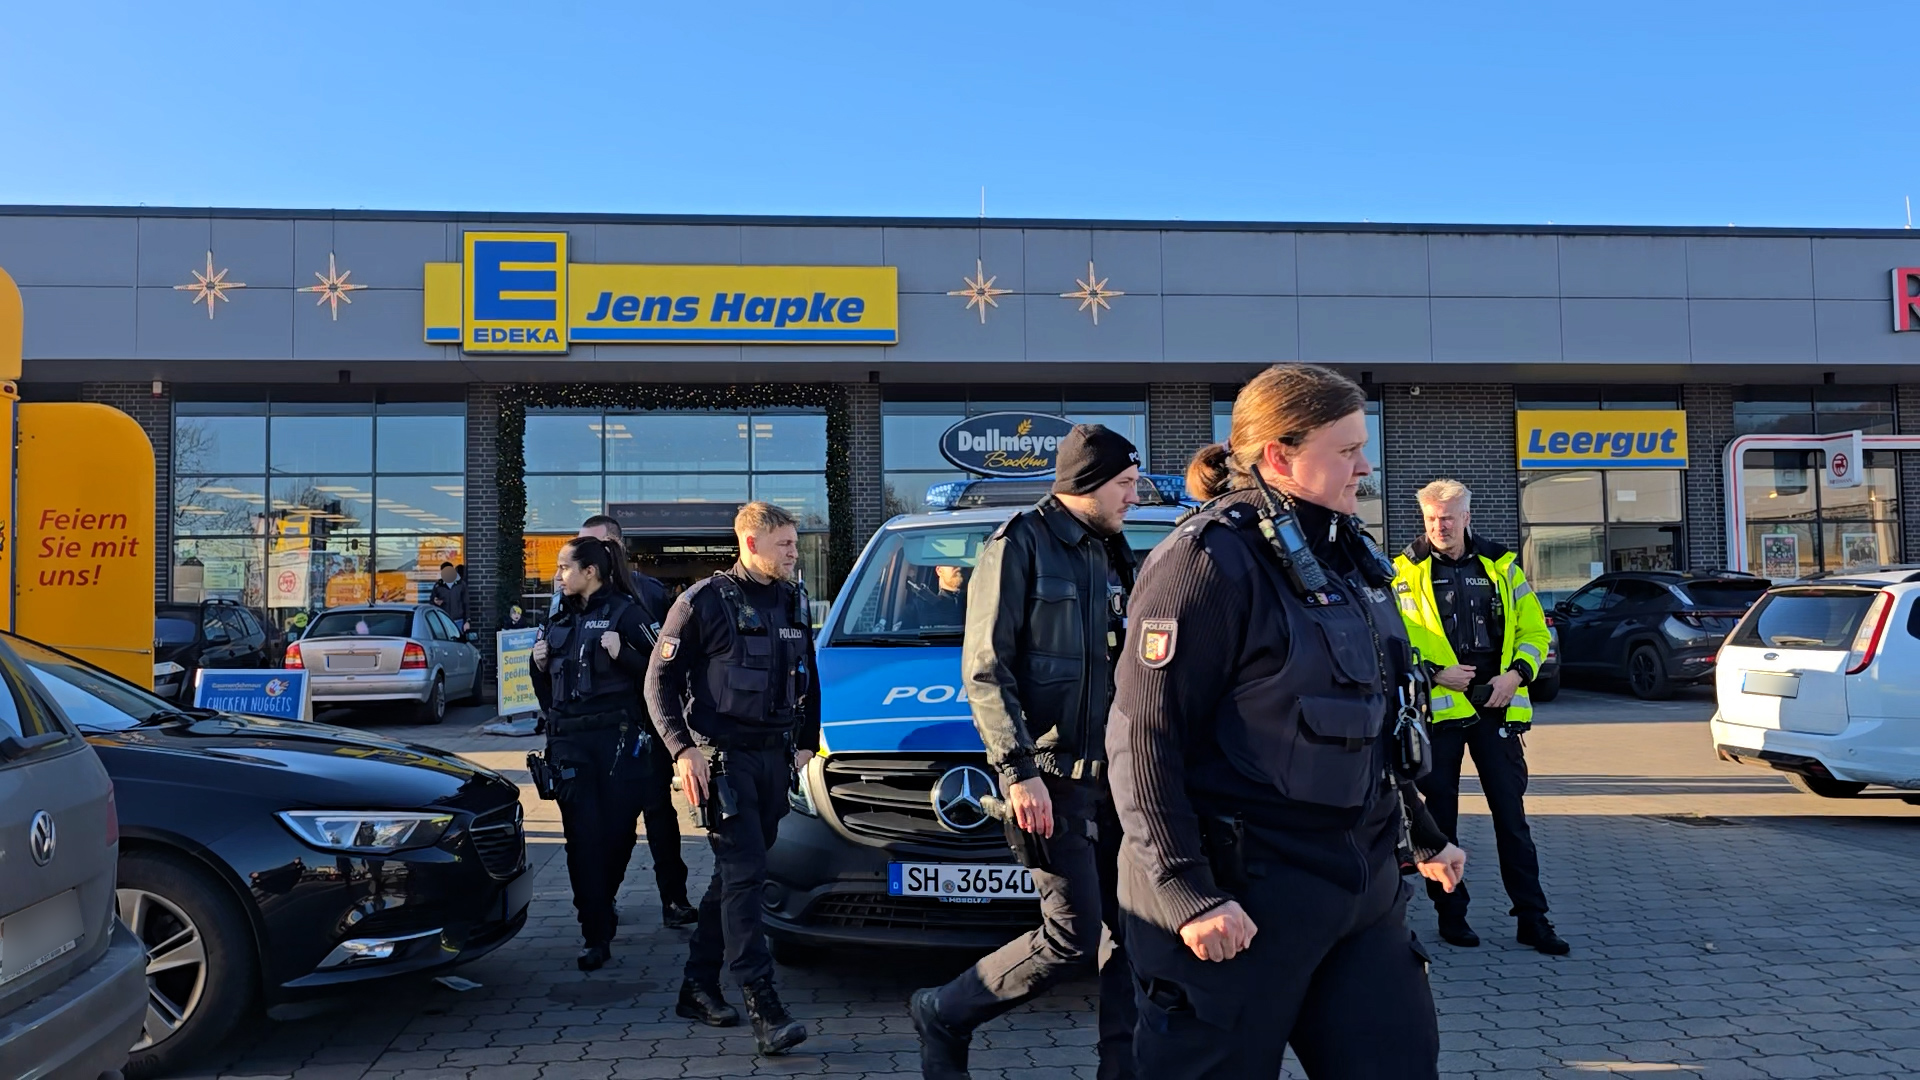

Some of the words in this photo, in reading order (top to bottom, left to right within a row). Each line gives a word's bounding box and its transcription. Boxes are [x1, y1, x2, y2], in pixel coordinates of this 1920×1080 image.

[474, 241, 556, 320] E
[586, 292, 700, 322] Jens
[710, 292, 865, 328] Hapke
[474, 328, 559, 343] EDEKA
[1528, 429, 1678, 457] Leergut
[38, 508, 128, 530] Feiern
[38, 536, 81, 558] Sie
[91, 535, 140, 558] mit
[38, 564, 102, 586] uns!
[206, 697, 248, 712] CHICKEN
[250, 697, 292, 713] NUGGETS
[882, 685, 970, 705] POL
[908, 867, 939, 892] SH
[957, 869, 1035, 894] 36540
